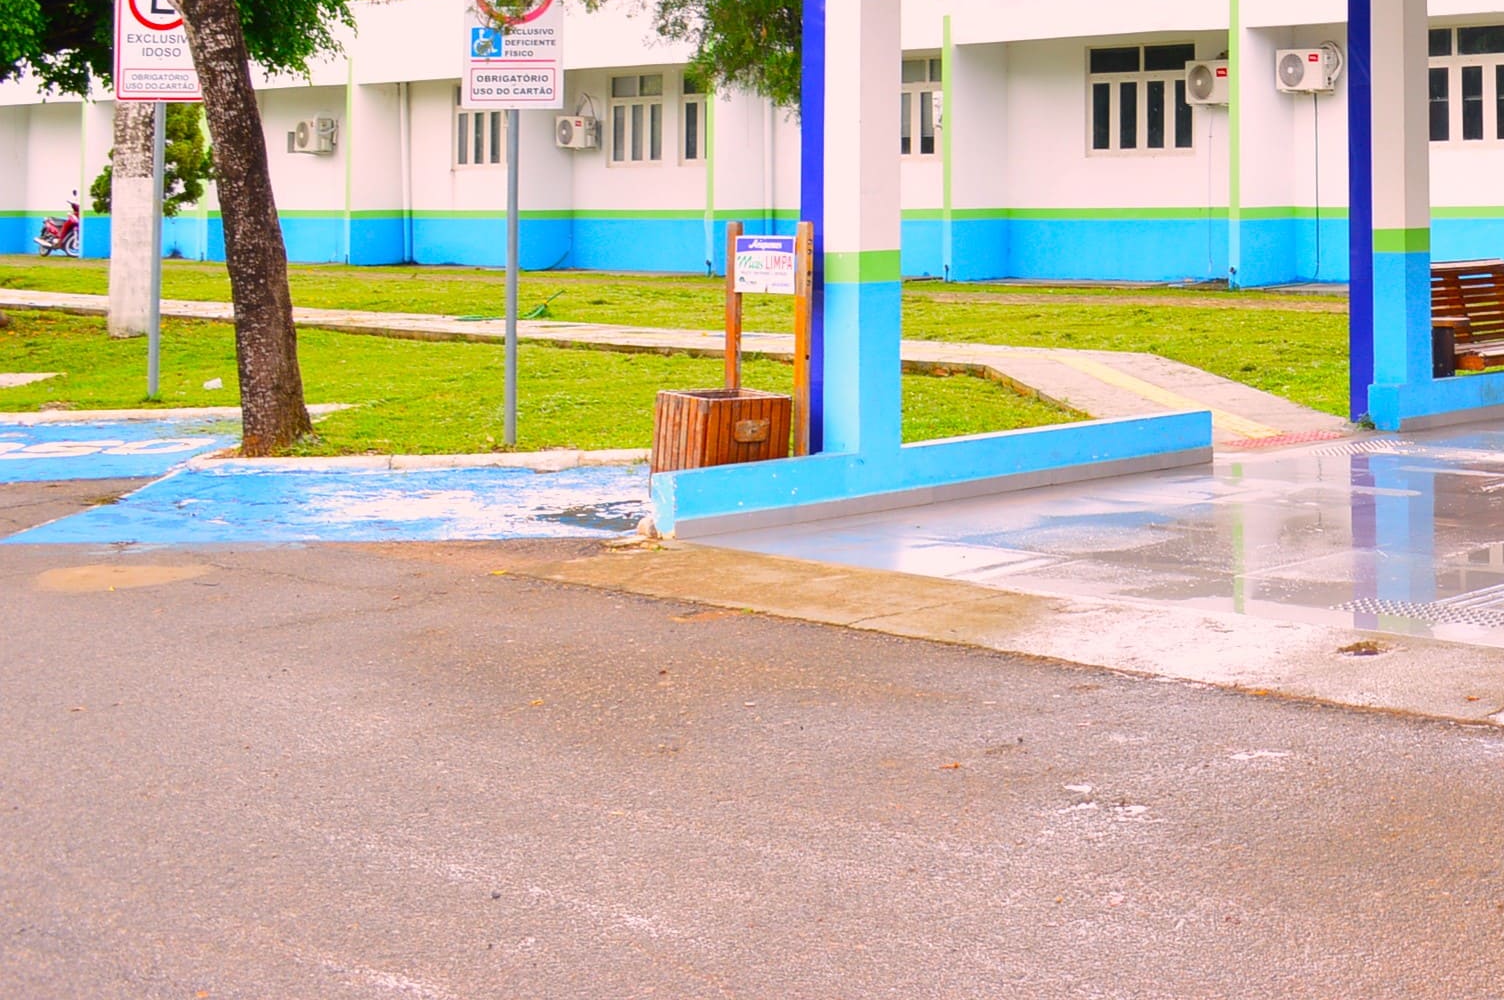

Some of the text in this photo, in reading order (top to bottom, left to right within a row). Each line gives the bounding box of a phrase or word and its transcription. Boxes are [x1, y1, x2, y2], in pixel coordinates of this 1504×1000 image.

[504, 28, 555, 36] XCLUSIVO
[127, 34, 188, 44] EXCLUSIV
[504, 39, 557, 47] DEFICIENTE
[141, 47, 182, 58] IDOSO
[504, 48, 534, 57] FÍSICO
[131, 72, 190, 81] OBRIGATÓRIO
[476, 73, 550, 83] OBRIGATÓRIO
[125, 82, 144, 90] USO
[145, 82, 158, 90] DO
[473, 86, 554, 96] USO DO CARTÃO
[765, 255, 793, 270] LIMPA
